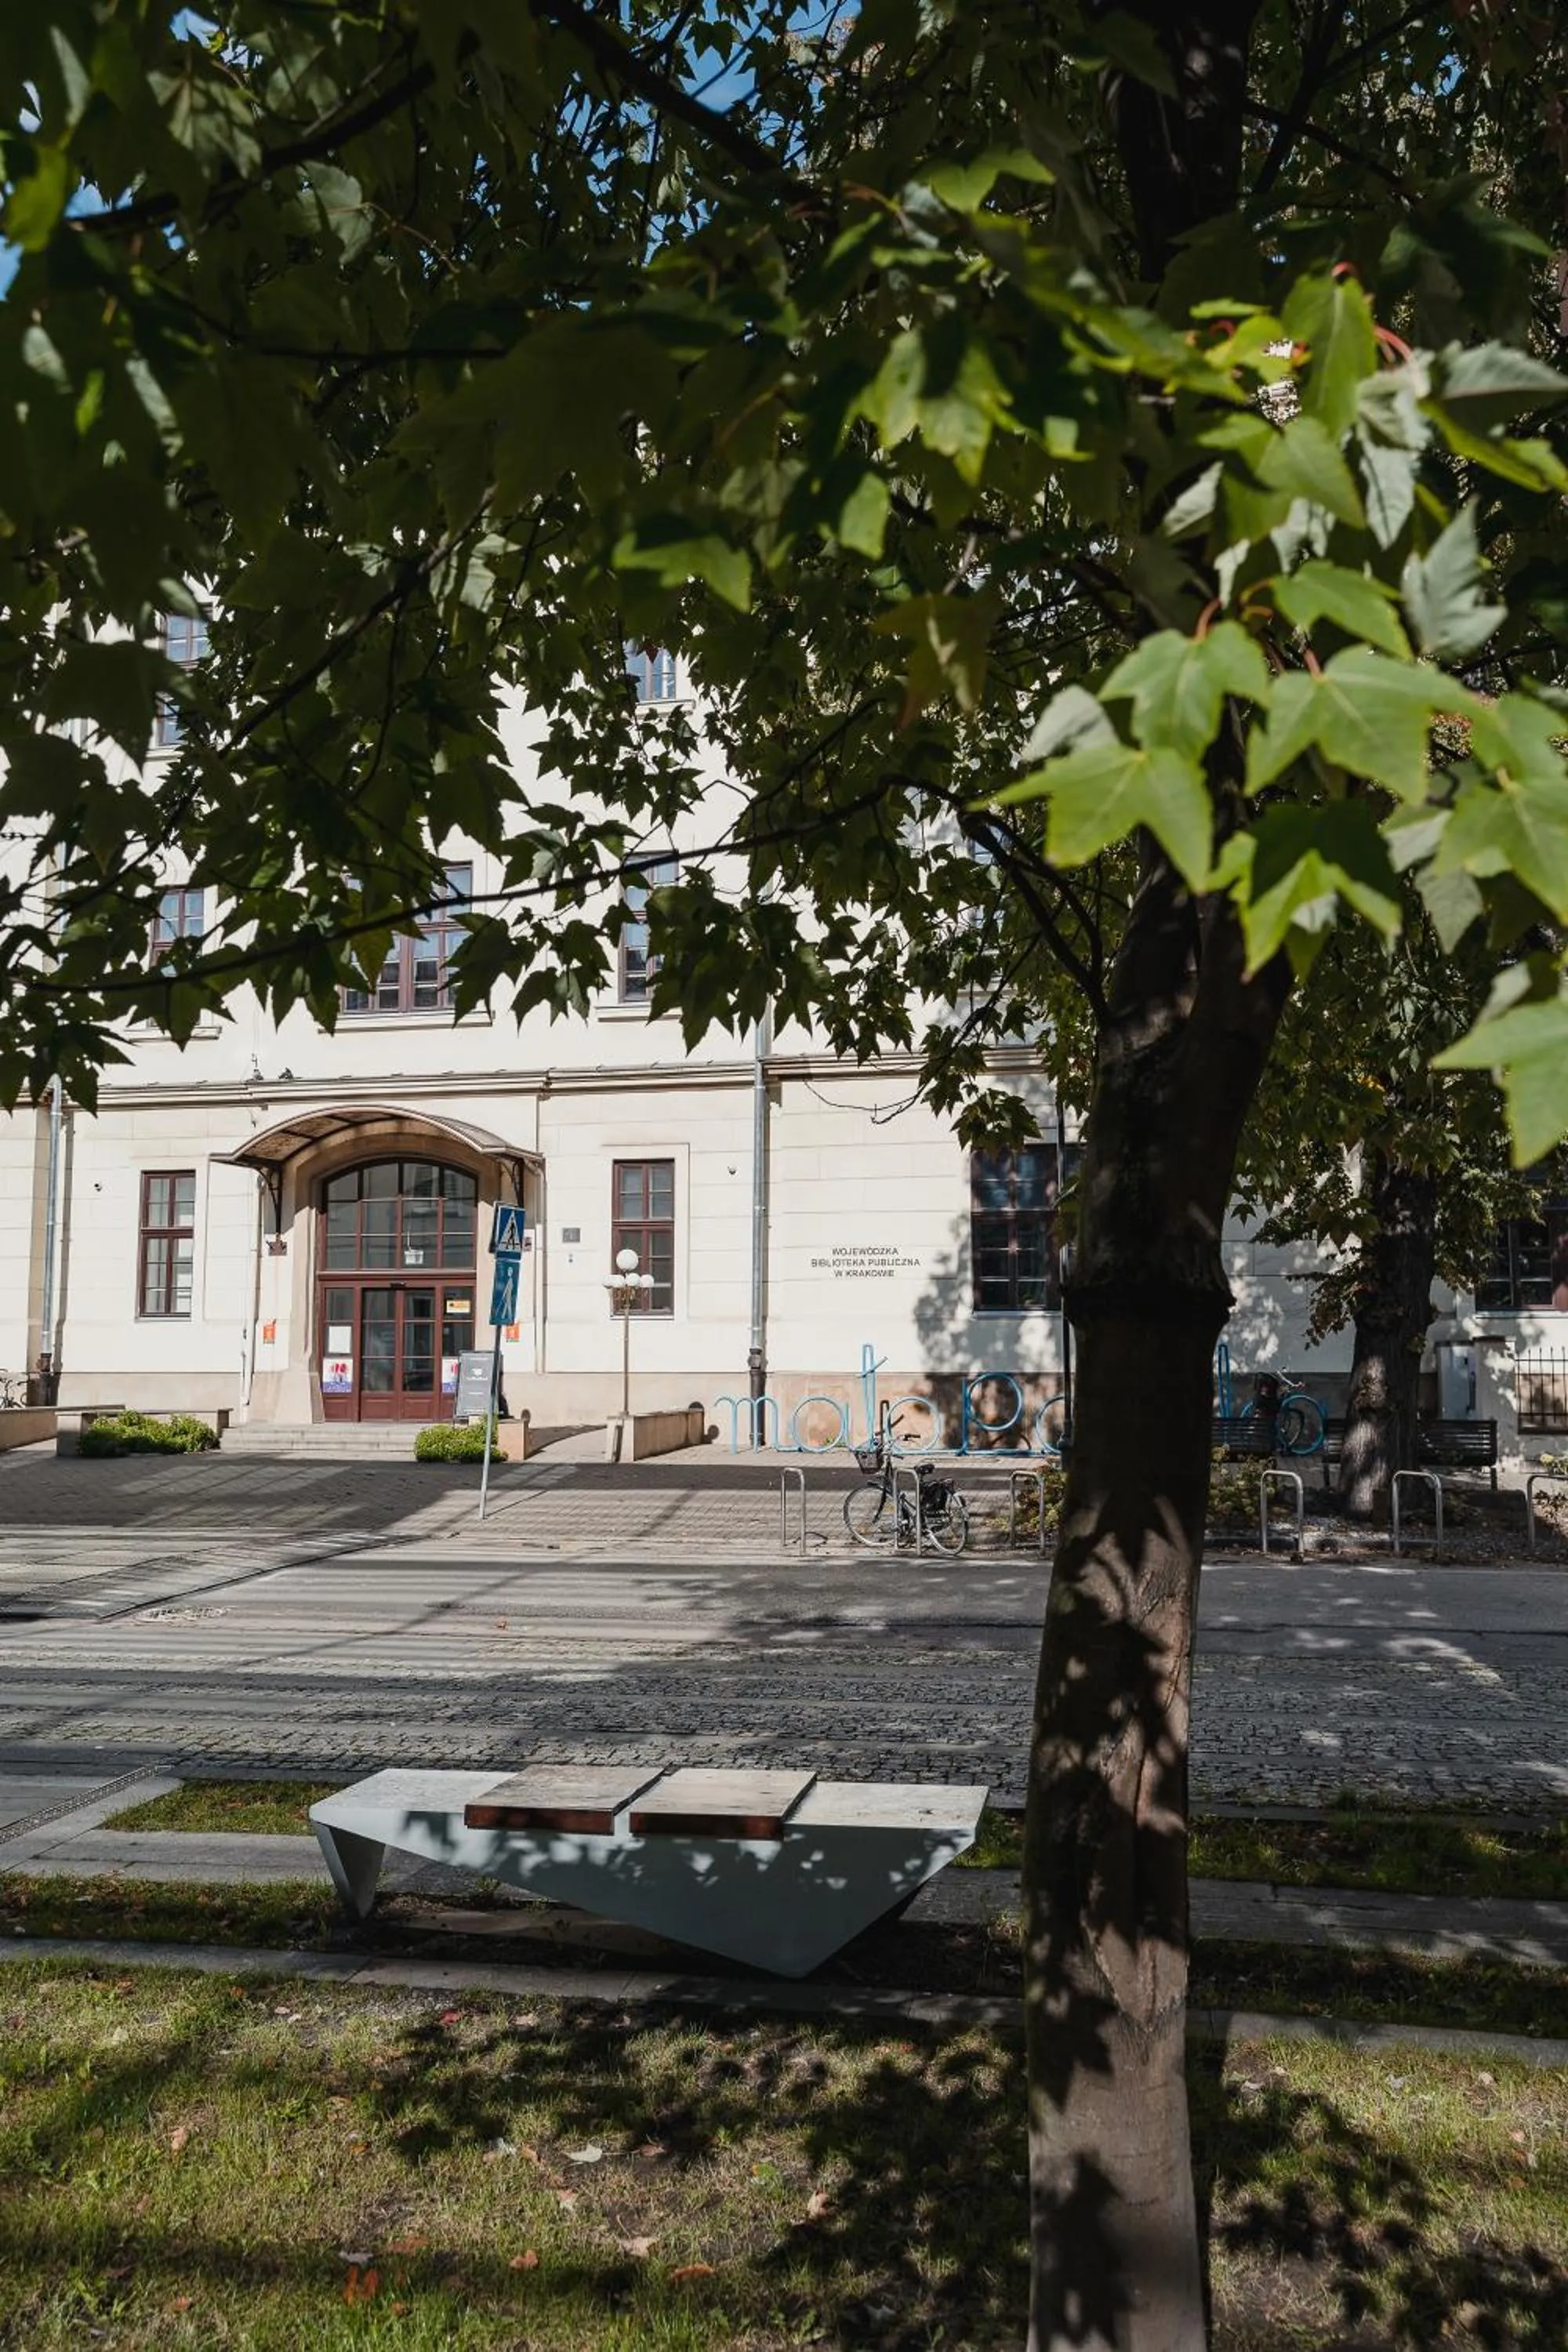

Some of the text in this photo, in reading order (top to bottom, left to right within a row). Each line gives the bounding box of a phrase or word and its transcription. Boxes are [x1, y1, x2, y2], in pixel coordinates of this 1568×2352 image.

[832, 1247, 899, 1255] WOJEWÓDZKA
[811, 1258, 921, 1268] BIBLIOTEKA PUBLICZNA
[834, 1269, 895, 1278] W KRAKOWIE
